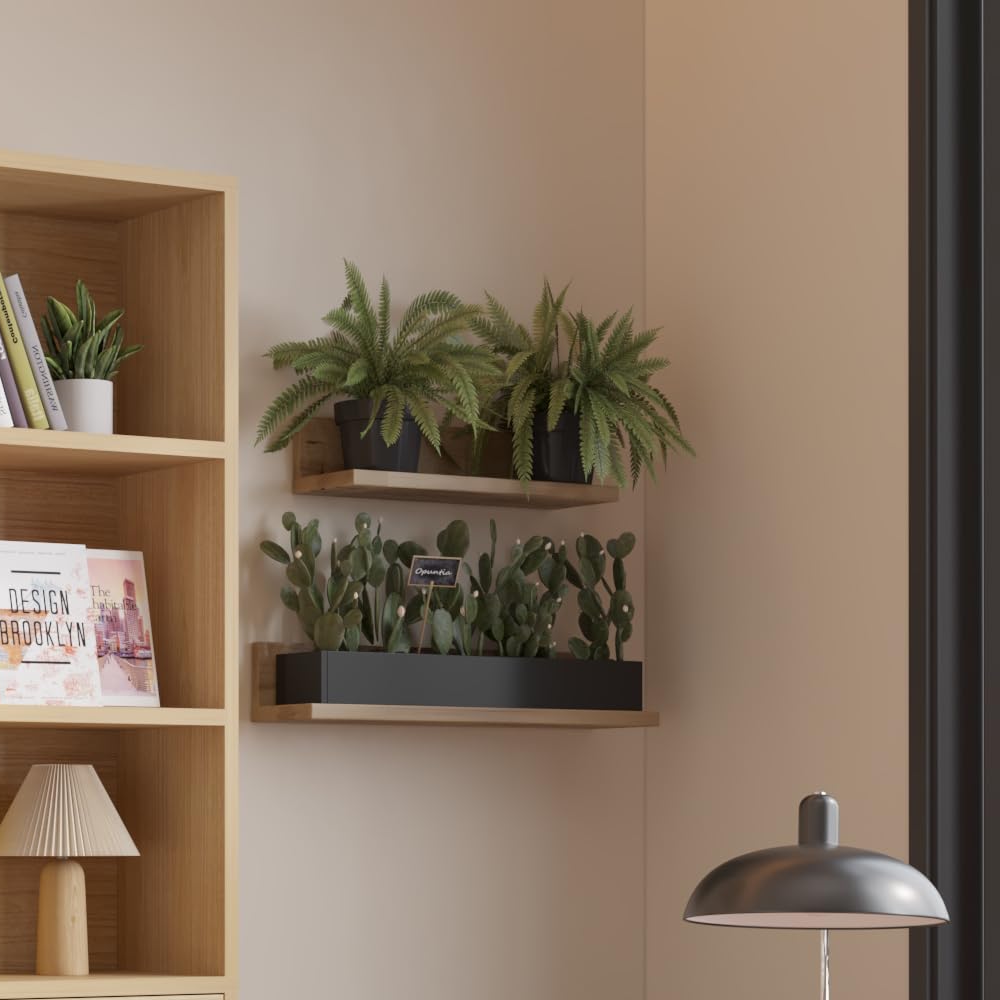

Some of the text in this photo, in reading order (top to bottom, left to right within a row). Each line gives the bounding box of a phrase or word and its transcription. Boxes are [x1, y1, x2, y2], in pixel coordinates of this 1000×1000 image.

[415, 567, 453, 576] Opuntia
[91, 585, 111, 597] The
[8, 588, 70, 615] DESIGN
[0, 619, 87, 647] BROOKLYN
